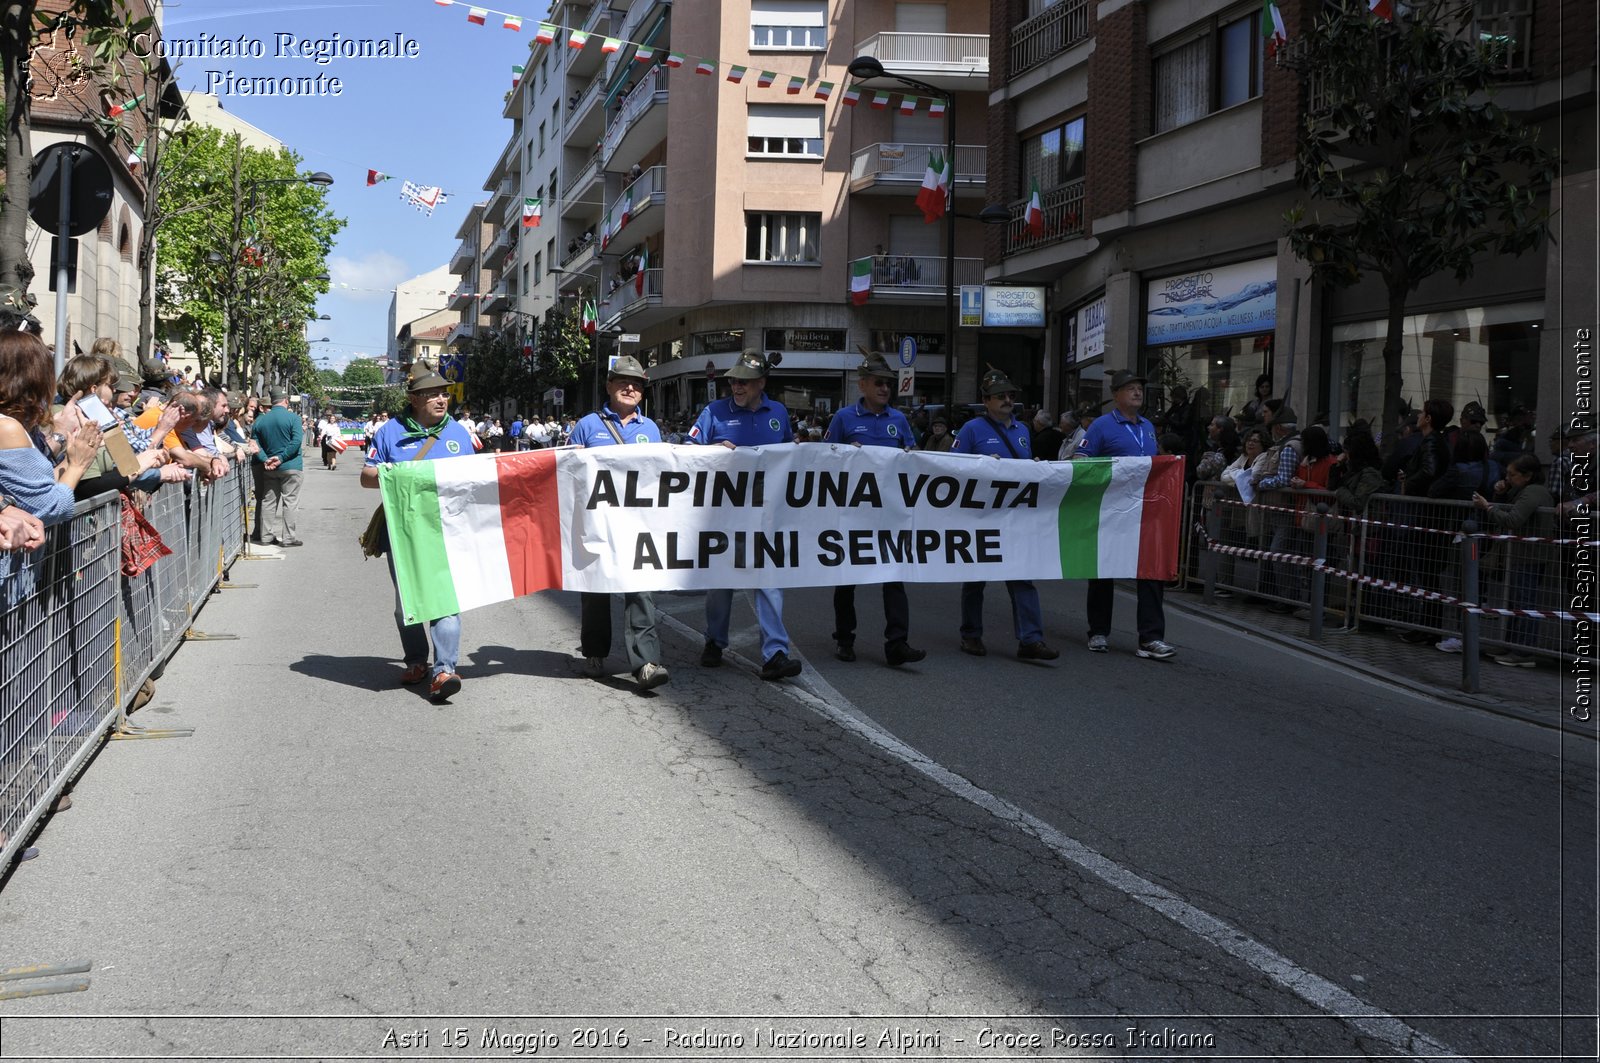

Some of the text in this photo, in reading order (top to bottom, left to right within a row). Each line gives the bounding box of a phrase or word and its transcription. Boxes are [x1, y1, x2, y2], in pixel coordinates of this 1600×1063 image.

[1165, 272, 1213, 292] PROGETTO
[996, 291, 1036, 299] PROGETTO
[1164, 285, 1212, 304] BENESSERE
[1169, 318, 1204, 333] TRATTAMENTO
[1204, 316, 1223, 329] ACQUA
[1227, 312, 1255, 326] WELLNESS
[586, 470, 1040, 510] ALPINI UNA VOLTA
[633, 528, 1003, 570] ALPINI SEMPRE
